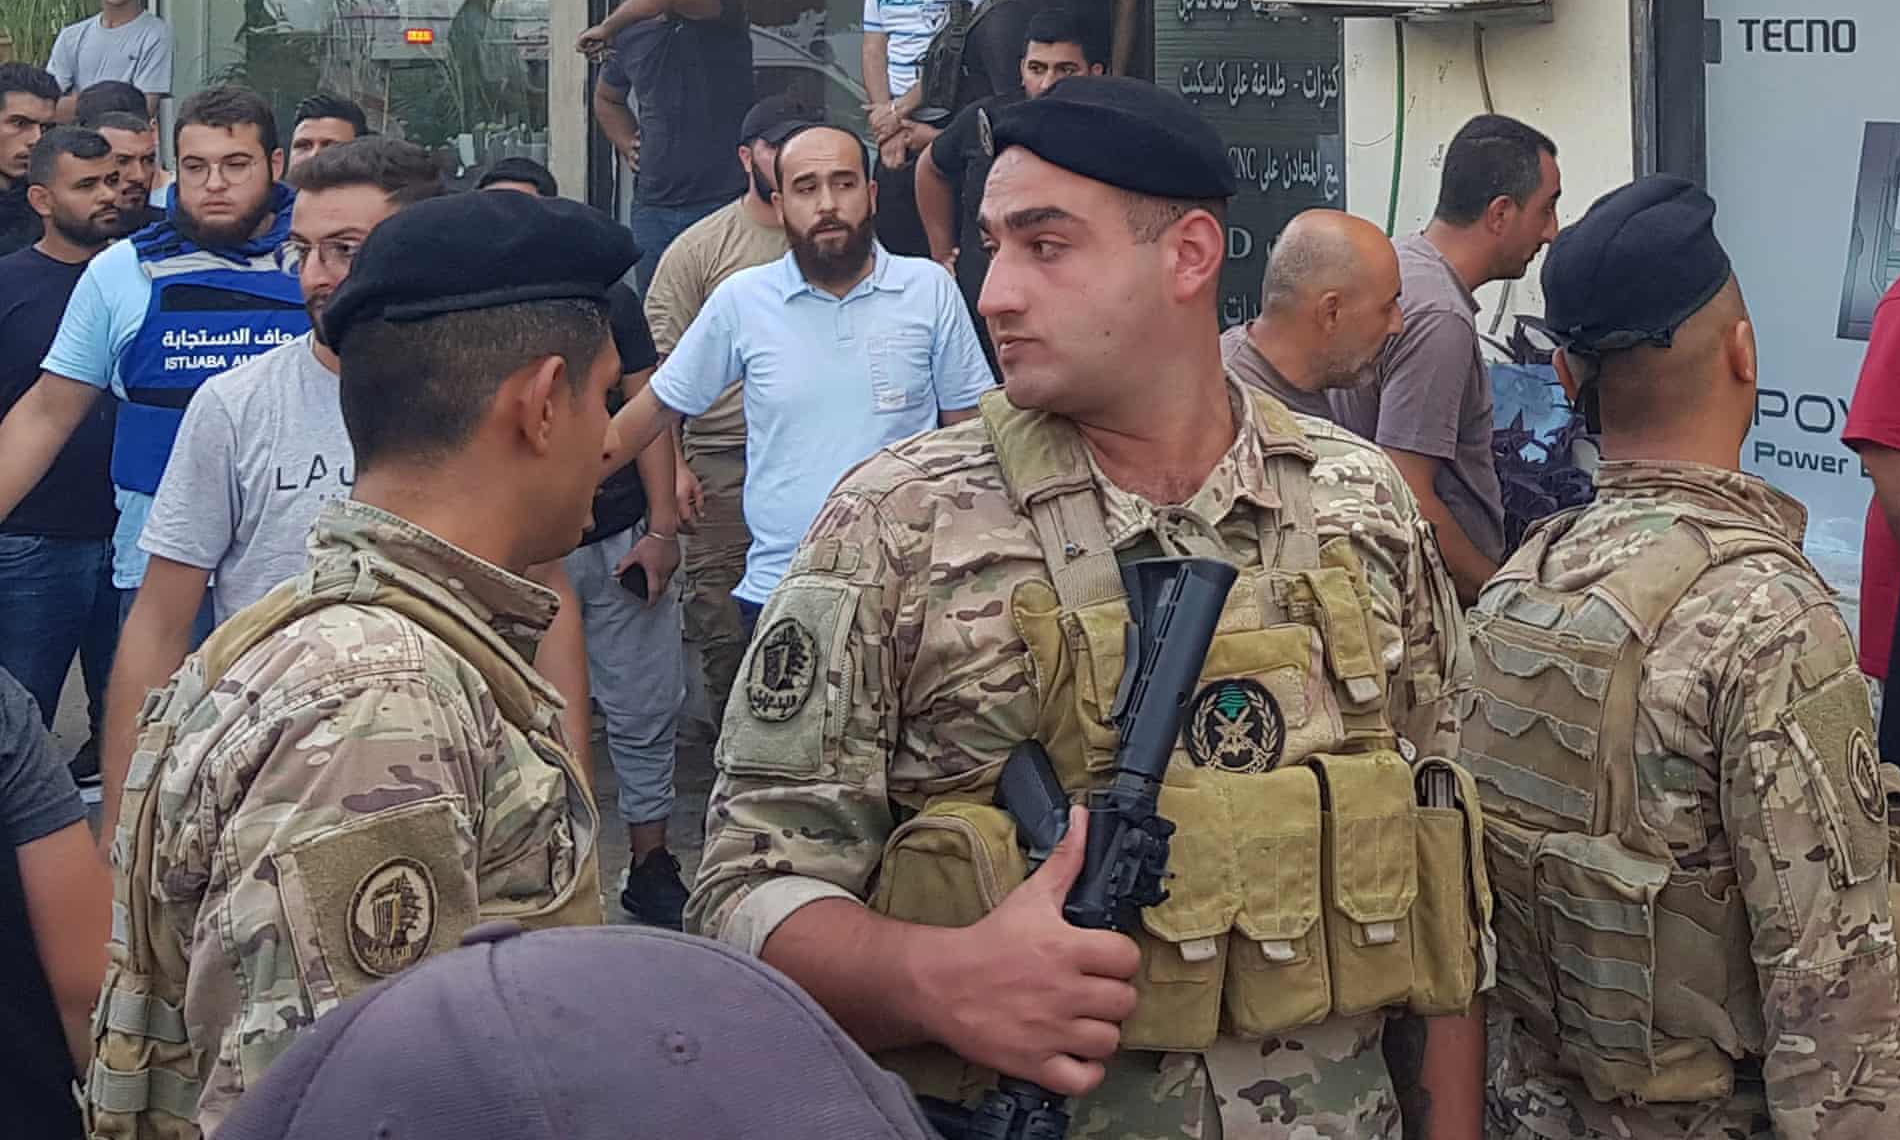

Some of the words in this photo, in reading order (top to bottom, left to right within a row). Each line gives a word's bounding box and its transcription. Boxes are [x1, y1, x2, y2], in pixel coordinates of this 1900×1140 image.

[1738, 17, 1857, 53] TECNO
[1754, 389, 1850, 434] PO
[1754, 442, 1849, 477] Power
